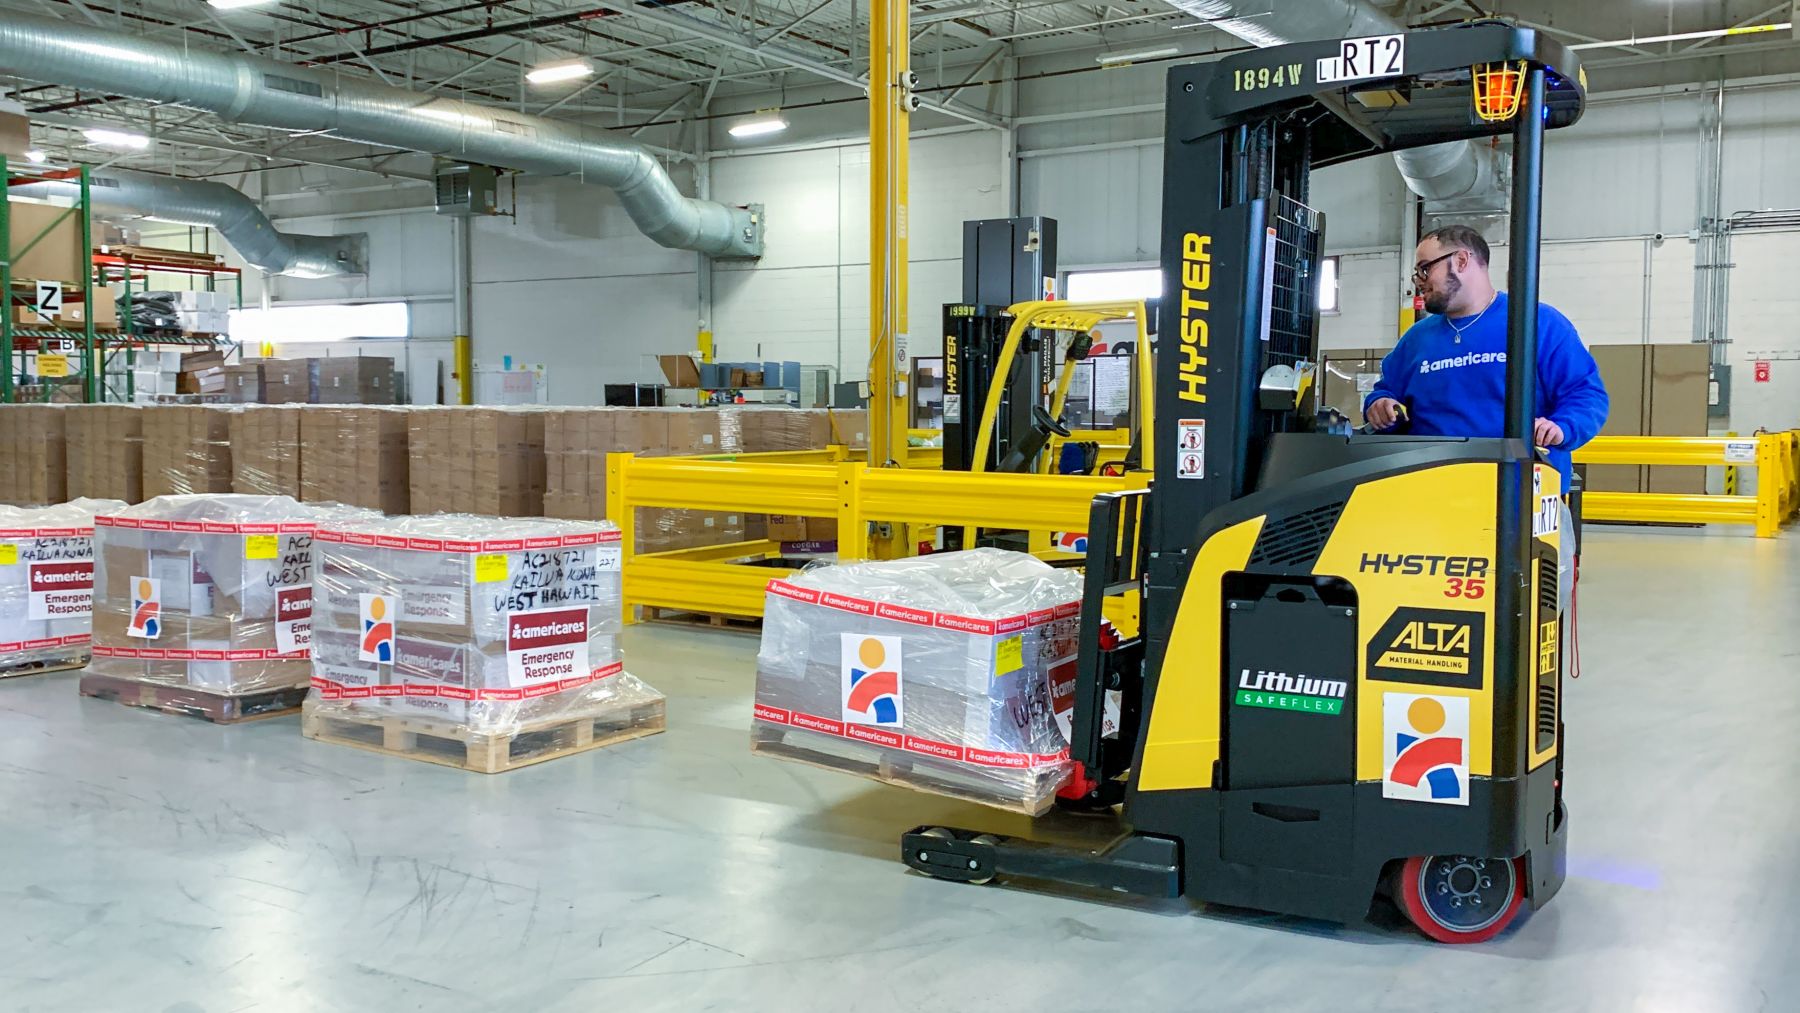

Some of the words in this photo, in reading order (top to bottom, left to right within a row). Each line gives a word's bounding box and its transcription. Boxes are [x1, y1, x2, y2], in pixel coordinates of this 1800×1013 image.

[1343, 37, 1401, 77] RT2
[1234, 63, 1302, 92] 1894W
[40, 285, 59, 310] Z
[1178, 231, 1212, 403] HYSTER
[946, 335, 957, 394] HYSTER
[522, 550, 585, 570] AC218721
[1359, 552, 1489, 578] HYSTER
[266, 565, 312, 587] WEST
[511, 568, 564, 592] KAILUA
[566, 565, 597, 582] KONA
[1443, 577, 1486, 600] 35
[494, 592, 538, 612] WEST
[541, 584, 600, 604] HAWAII
[777, 584, 814, 600] americares
[829, 596, 870, 612] americares
[884, 608, 928, 623] americares
[945, 618, 990, 632] americares
[522, 622, 584, 639] americares
[1390, 621, 1471, 654] ALTA
[522, 650, 575, 666] Emergency
[524, 663, 573, 679] Response
[1389, 656, 1424, 666] MATERIAL
[1426, 659, 1462, 668] HANDLING
[1238, 669, 1348, 698] Lithium
[1244, 694, 1334, 712] SAFEFLEX
[799, 718, 839, 733] americares
[855, 730, 897, 744] americares
[914, 742, 958, 757] americares
[974, 753, 1024, 765] americares
